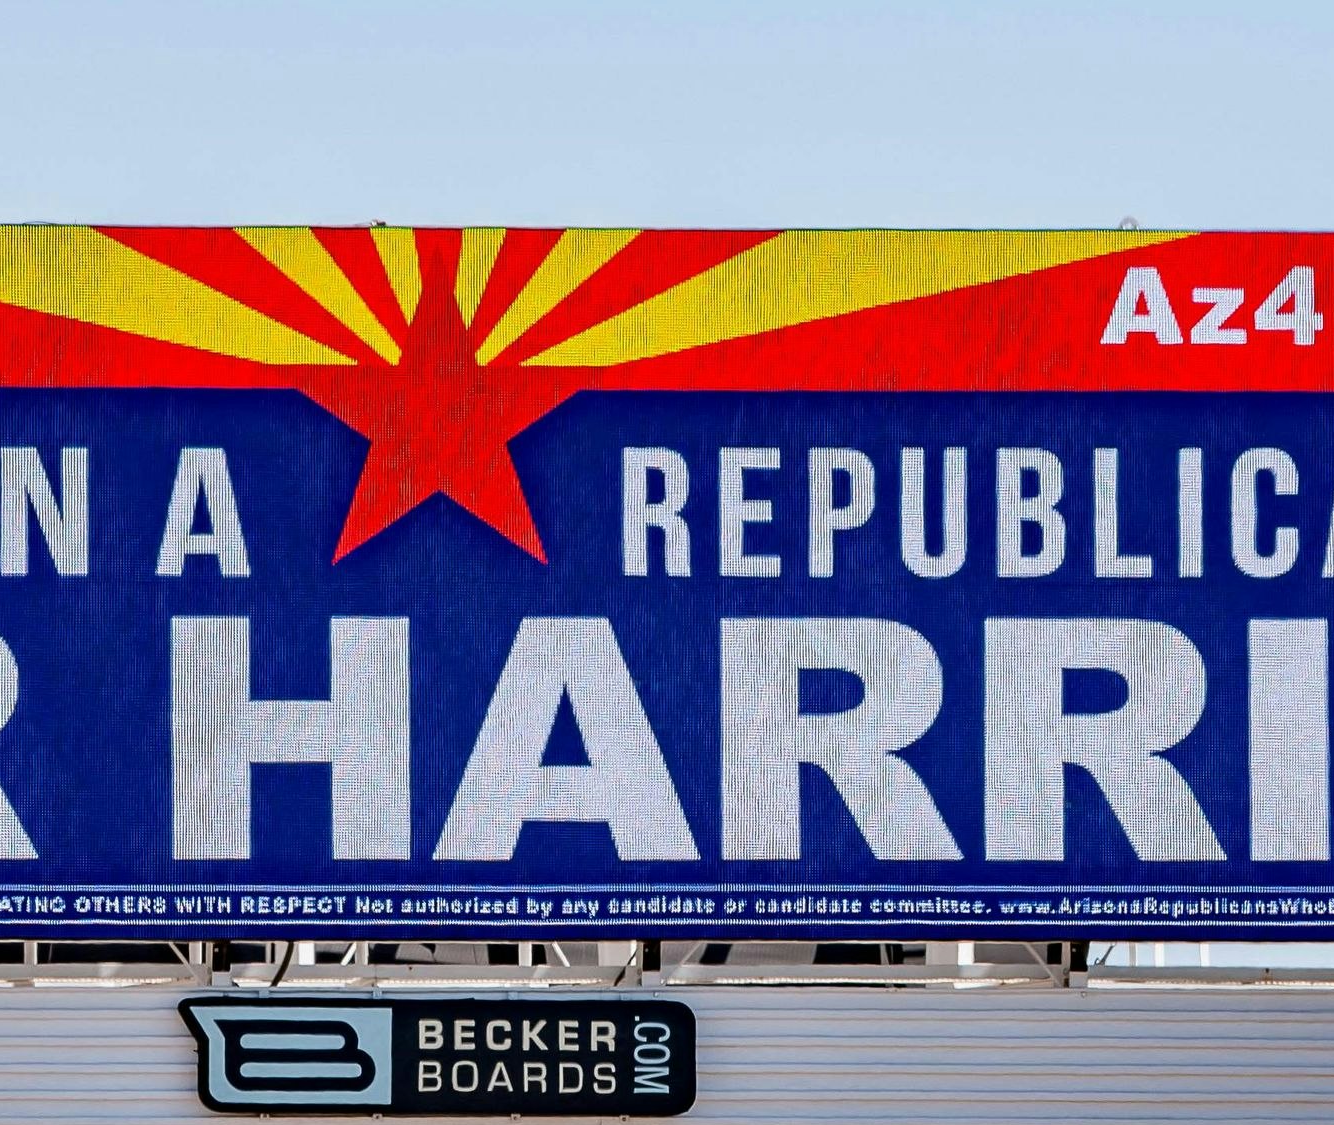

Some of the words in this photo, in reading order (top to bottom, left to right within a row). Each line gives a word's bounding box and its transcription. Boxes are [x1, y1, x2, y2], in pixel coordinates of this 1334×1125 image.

[74, 896, 166, 913] OTHERS
[175, 896, 231, 913] WITH
[241, 896, 346, 913] RESPECT
[356, 896, 393, 913] Not
[401, 896, 518, 913] authorized
[527, 896, 553, 917] by
[562, 898, 599, 917] any
[608, 896, 715, 913] candidate
[724, 900, 746, 914] or
[755, 897, 862, 914] candidate
[870, 897, 991, 914] committee.
[419, 1019, 616, 1051] BECKER
[633, 1015, 671, 1094] .COM
[419, 1060, 616, 1094] BOARDS
